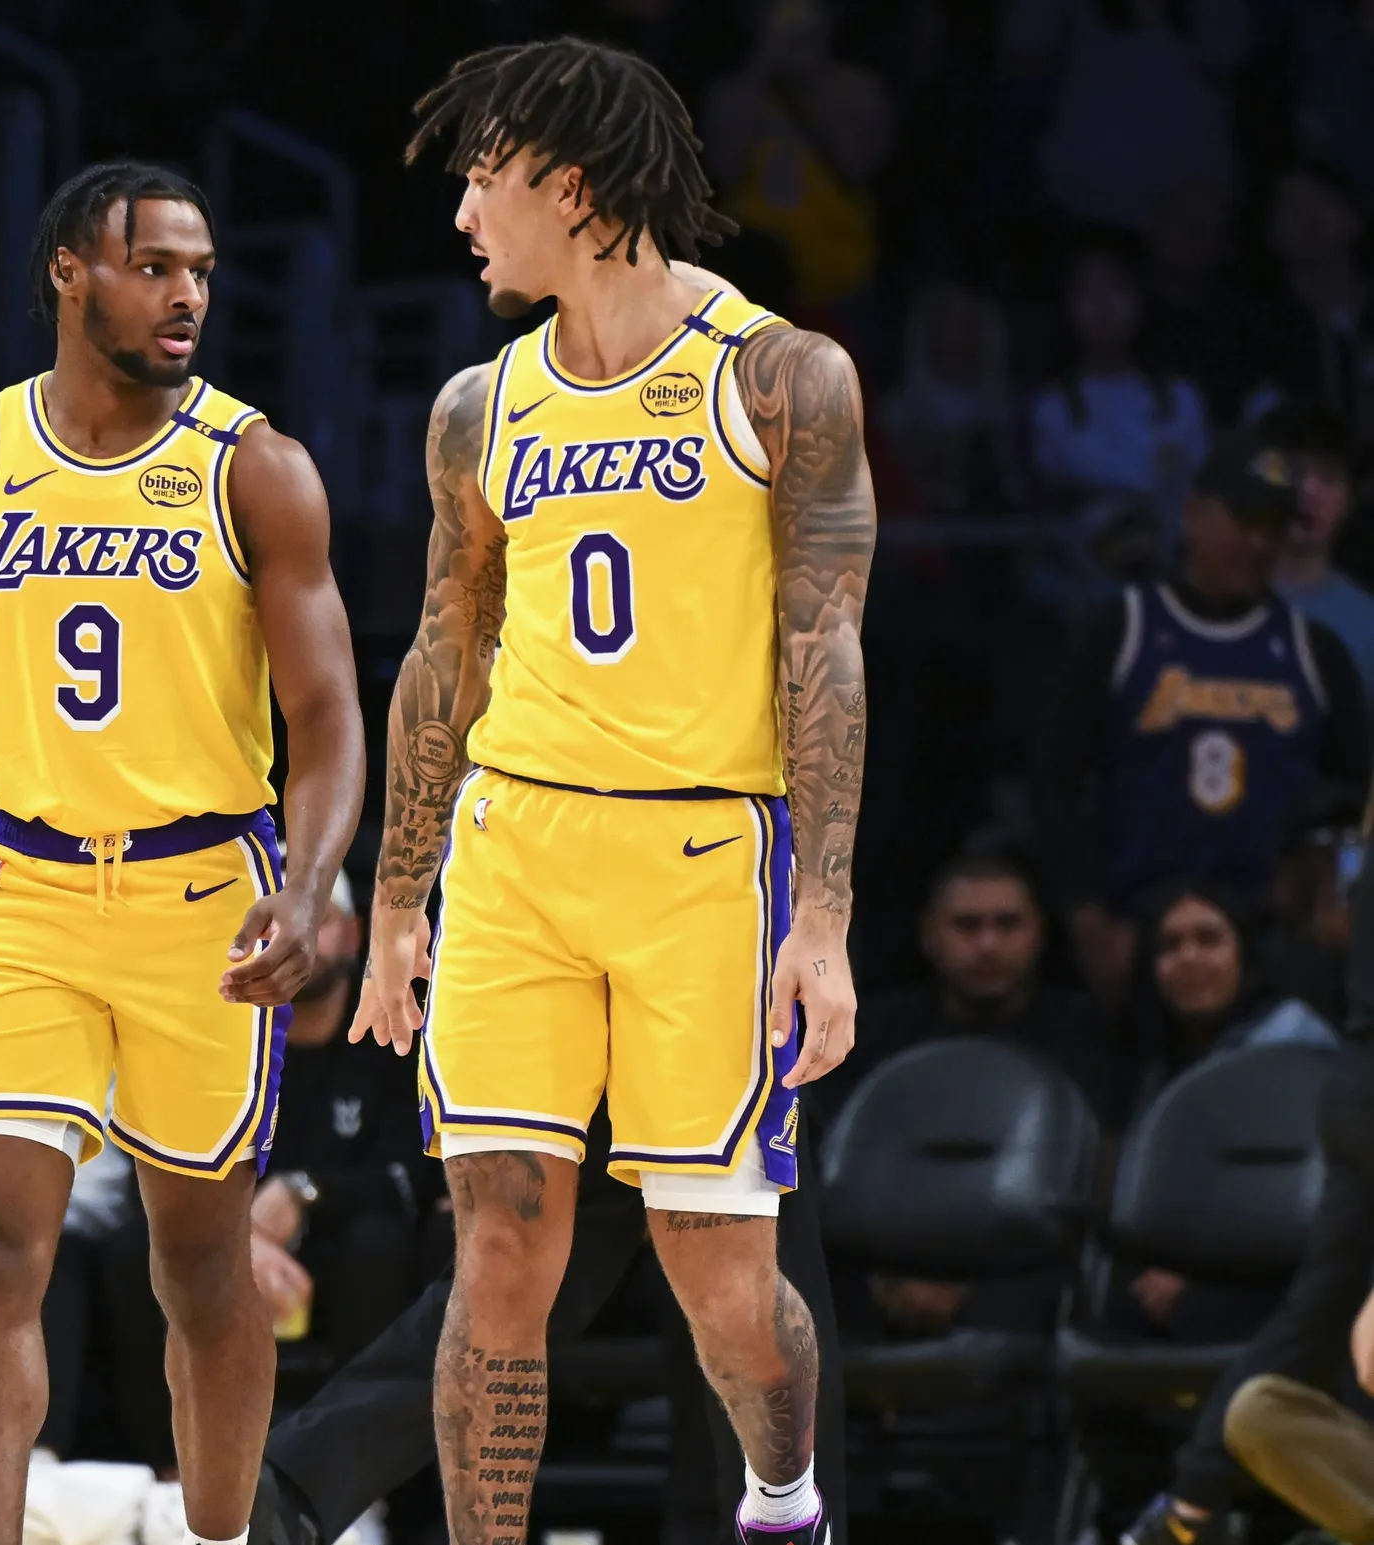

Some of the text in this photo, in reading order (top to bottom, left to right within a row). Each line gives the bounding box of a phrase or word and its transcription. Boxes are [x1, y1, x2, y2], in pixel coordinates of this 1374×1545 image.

[646, 384, 700, 403] bibigo
[195, 422, 214, 436] 44
[145, 474, 199, 496] bibigo
[502, 434, 708, 522] LAKERS
[569, 531, 637, 665] 0
[55, 602, 123, 731] 9
[1187, 727, 1246, 816] 8
[813, 959, 827, 977] 17
[507, 1359, 546, 1374] STRON
[478, 1468, 505, 1484] FOR
